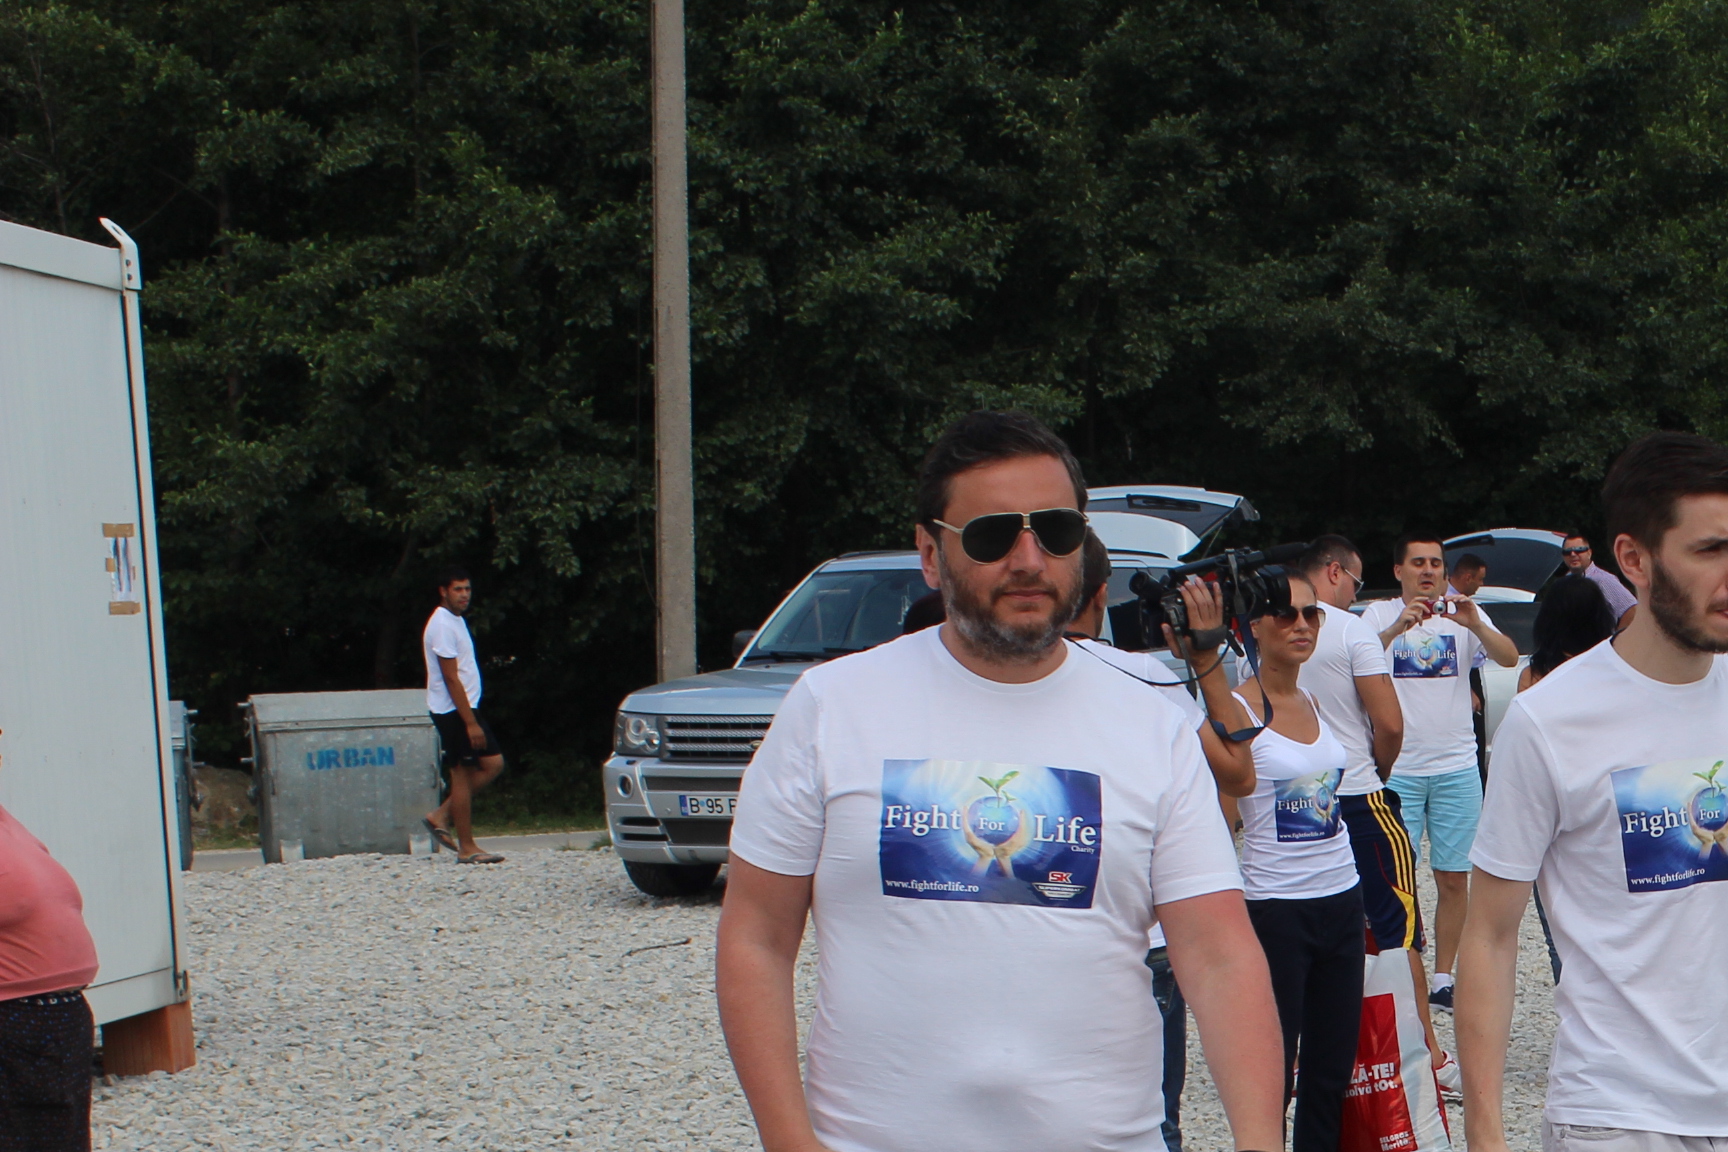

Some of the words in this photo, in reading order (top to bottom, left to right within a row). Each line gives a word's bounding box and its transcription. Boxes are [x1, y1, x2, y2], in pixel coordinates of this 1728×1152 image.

[1394, 649, 1416, 660] Fight
[1437, 649, 1456, 659] Life
[306, 746, 395, 771] URBAN
[689, 797, 700, 814] B
[706, 798, 724, 814] 95
[1277, 797, 1313, 814] Fight
[885, 804, 961, 836] Fight
[978, 817, 1005, 831] For
[1033, 814, 1097, 846] Life
[1623, 806, 1688, 838] Fight
[1699, 809, 1721, 820] For
[1631, 868, 1705, 885] www.fightforlife.ro
[885, 878, 980, 893] www.fightforlife.ro
